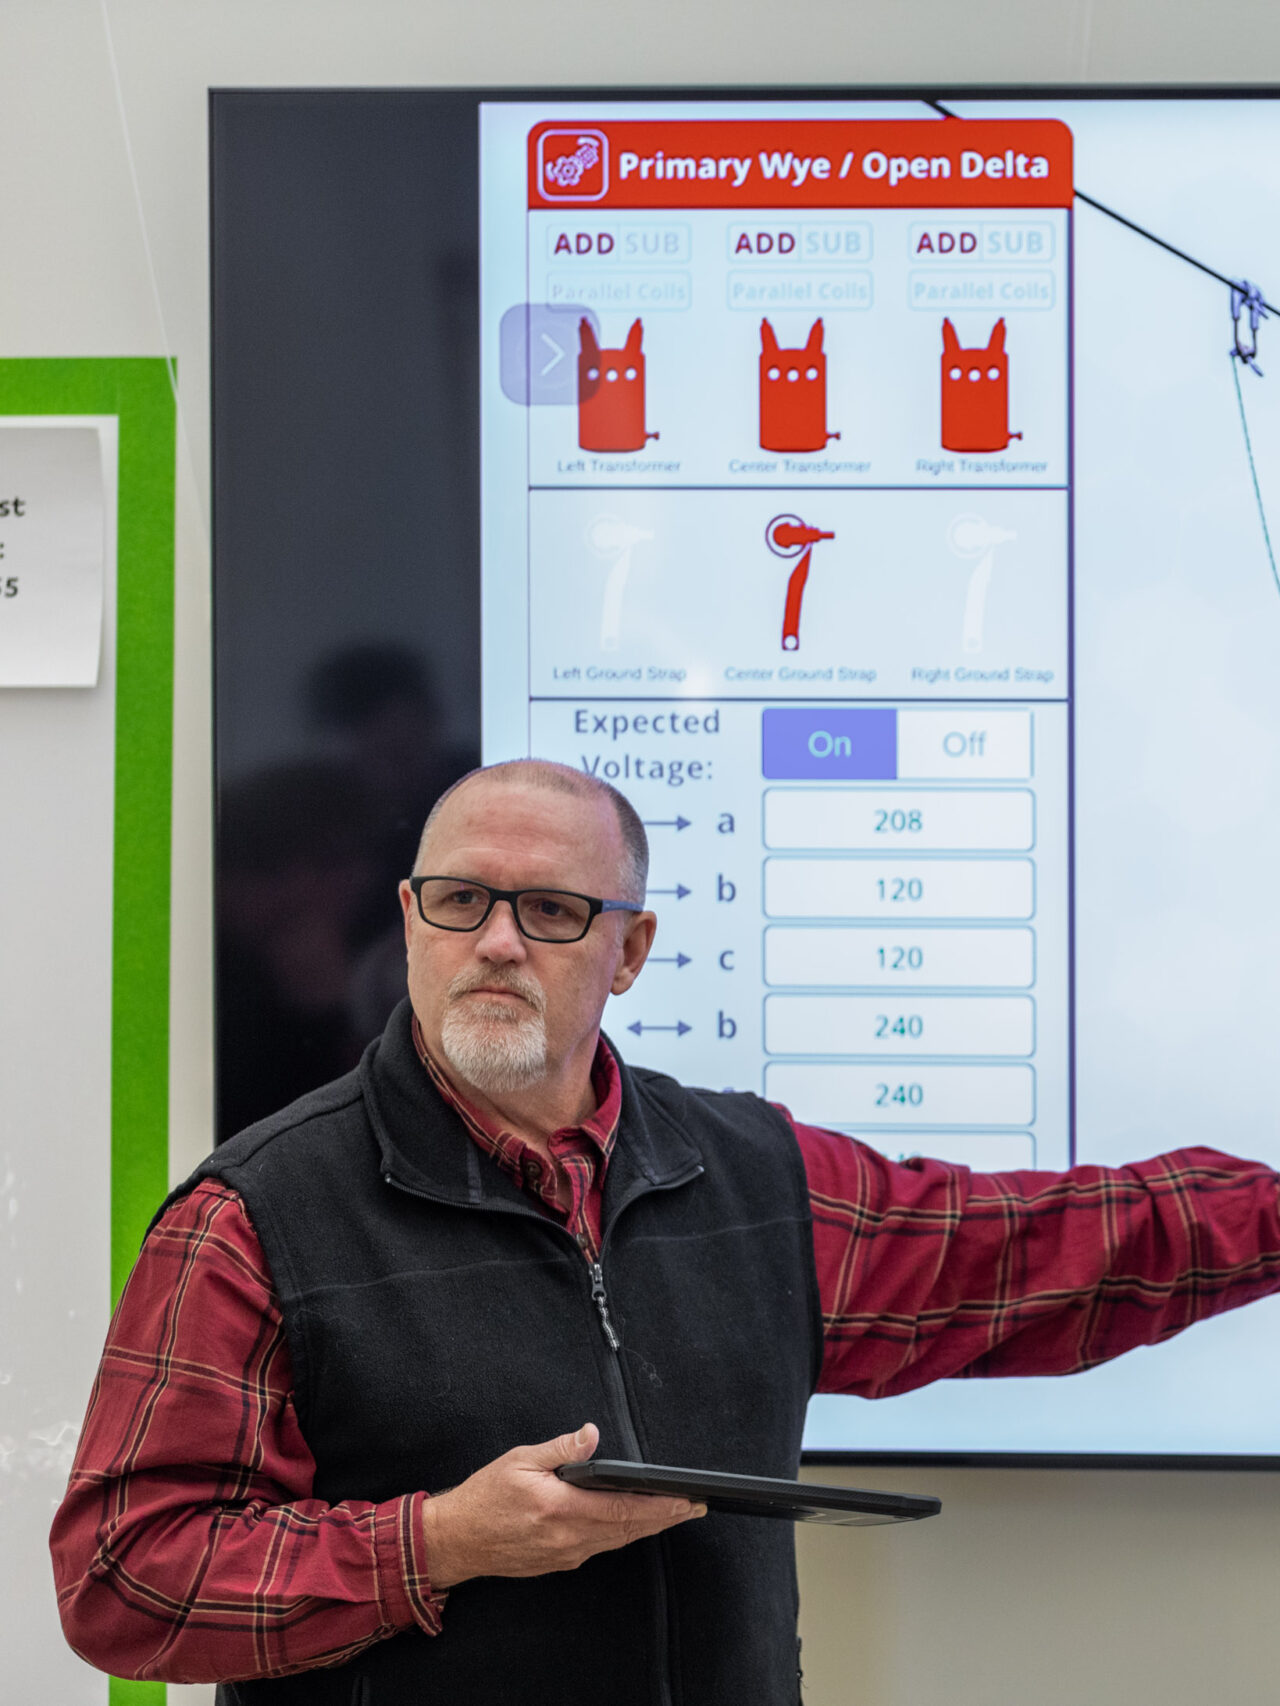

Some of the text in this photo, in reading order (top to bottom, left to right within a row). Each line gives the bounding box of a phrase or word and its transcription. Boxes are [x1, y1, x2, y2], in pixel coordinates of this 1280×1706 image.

[618, 150, 1049, 185] Primary Wye / Open Delta
[554, 232, 614, 255] ADD
[625, 232, 681, 255] SUB
[735, 232, 796, 255] ADD
[805, 231, 862, 255] SUB
[917, 232, 978, 255] ADD
[987, 231, 1044, 255] SUB
[552, 281, 687, 302] Parallel Coils
[732, 281, 868, 302] Parallel Coils
[913, 281, 1050, 302] Parallel Coils
[557, 458, 681, 473] Left Transformer
[729, 458, 871, 473] Center Transformer
[916, 458, 1048, 477] Right Transformer
[553, 666, 687, 684] Left Ground Strap
[724, 666, 877, 684] Center Ground Strap
[912, 666, 1054, 684] Right Ground Strap
[574, 709, 720, 741] Expected
[808, 730, 852, 758] On
[942, 730, 987, 758] Off
[581, 754, 713, 787] Voltage:
[717, 811, 735, 834] a
[874, 809, 923, 832] 208
[717, 874, 736, 902] b
[877, 878, 923, 901] 120
[719, 949, 735, 971] c
[877, 946, 923, 970] 120
[717, 1010, 737, 1039] b
[875, 1015, 923, 1038] 240
[875, 1083, 923, 1107] 240
